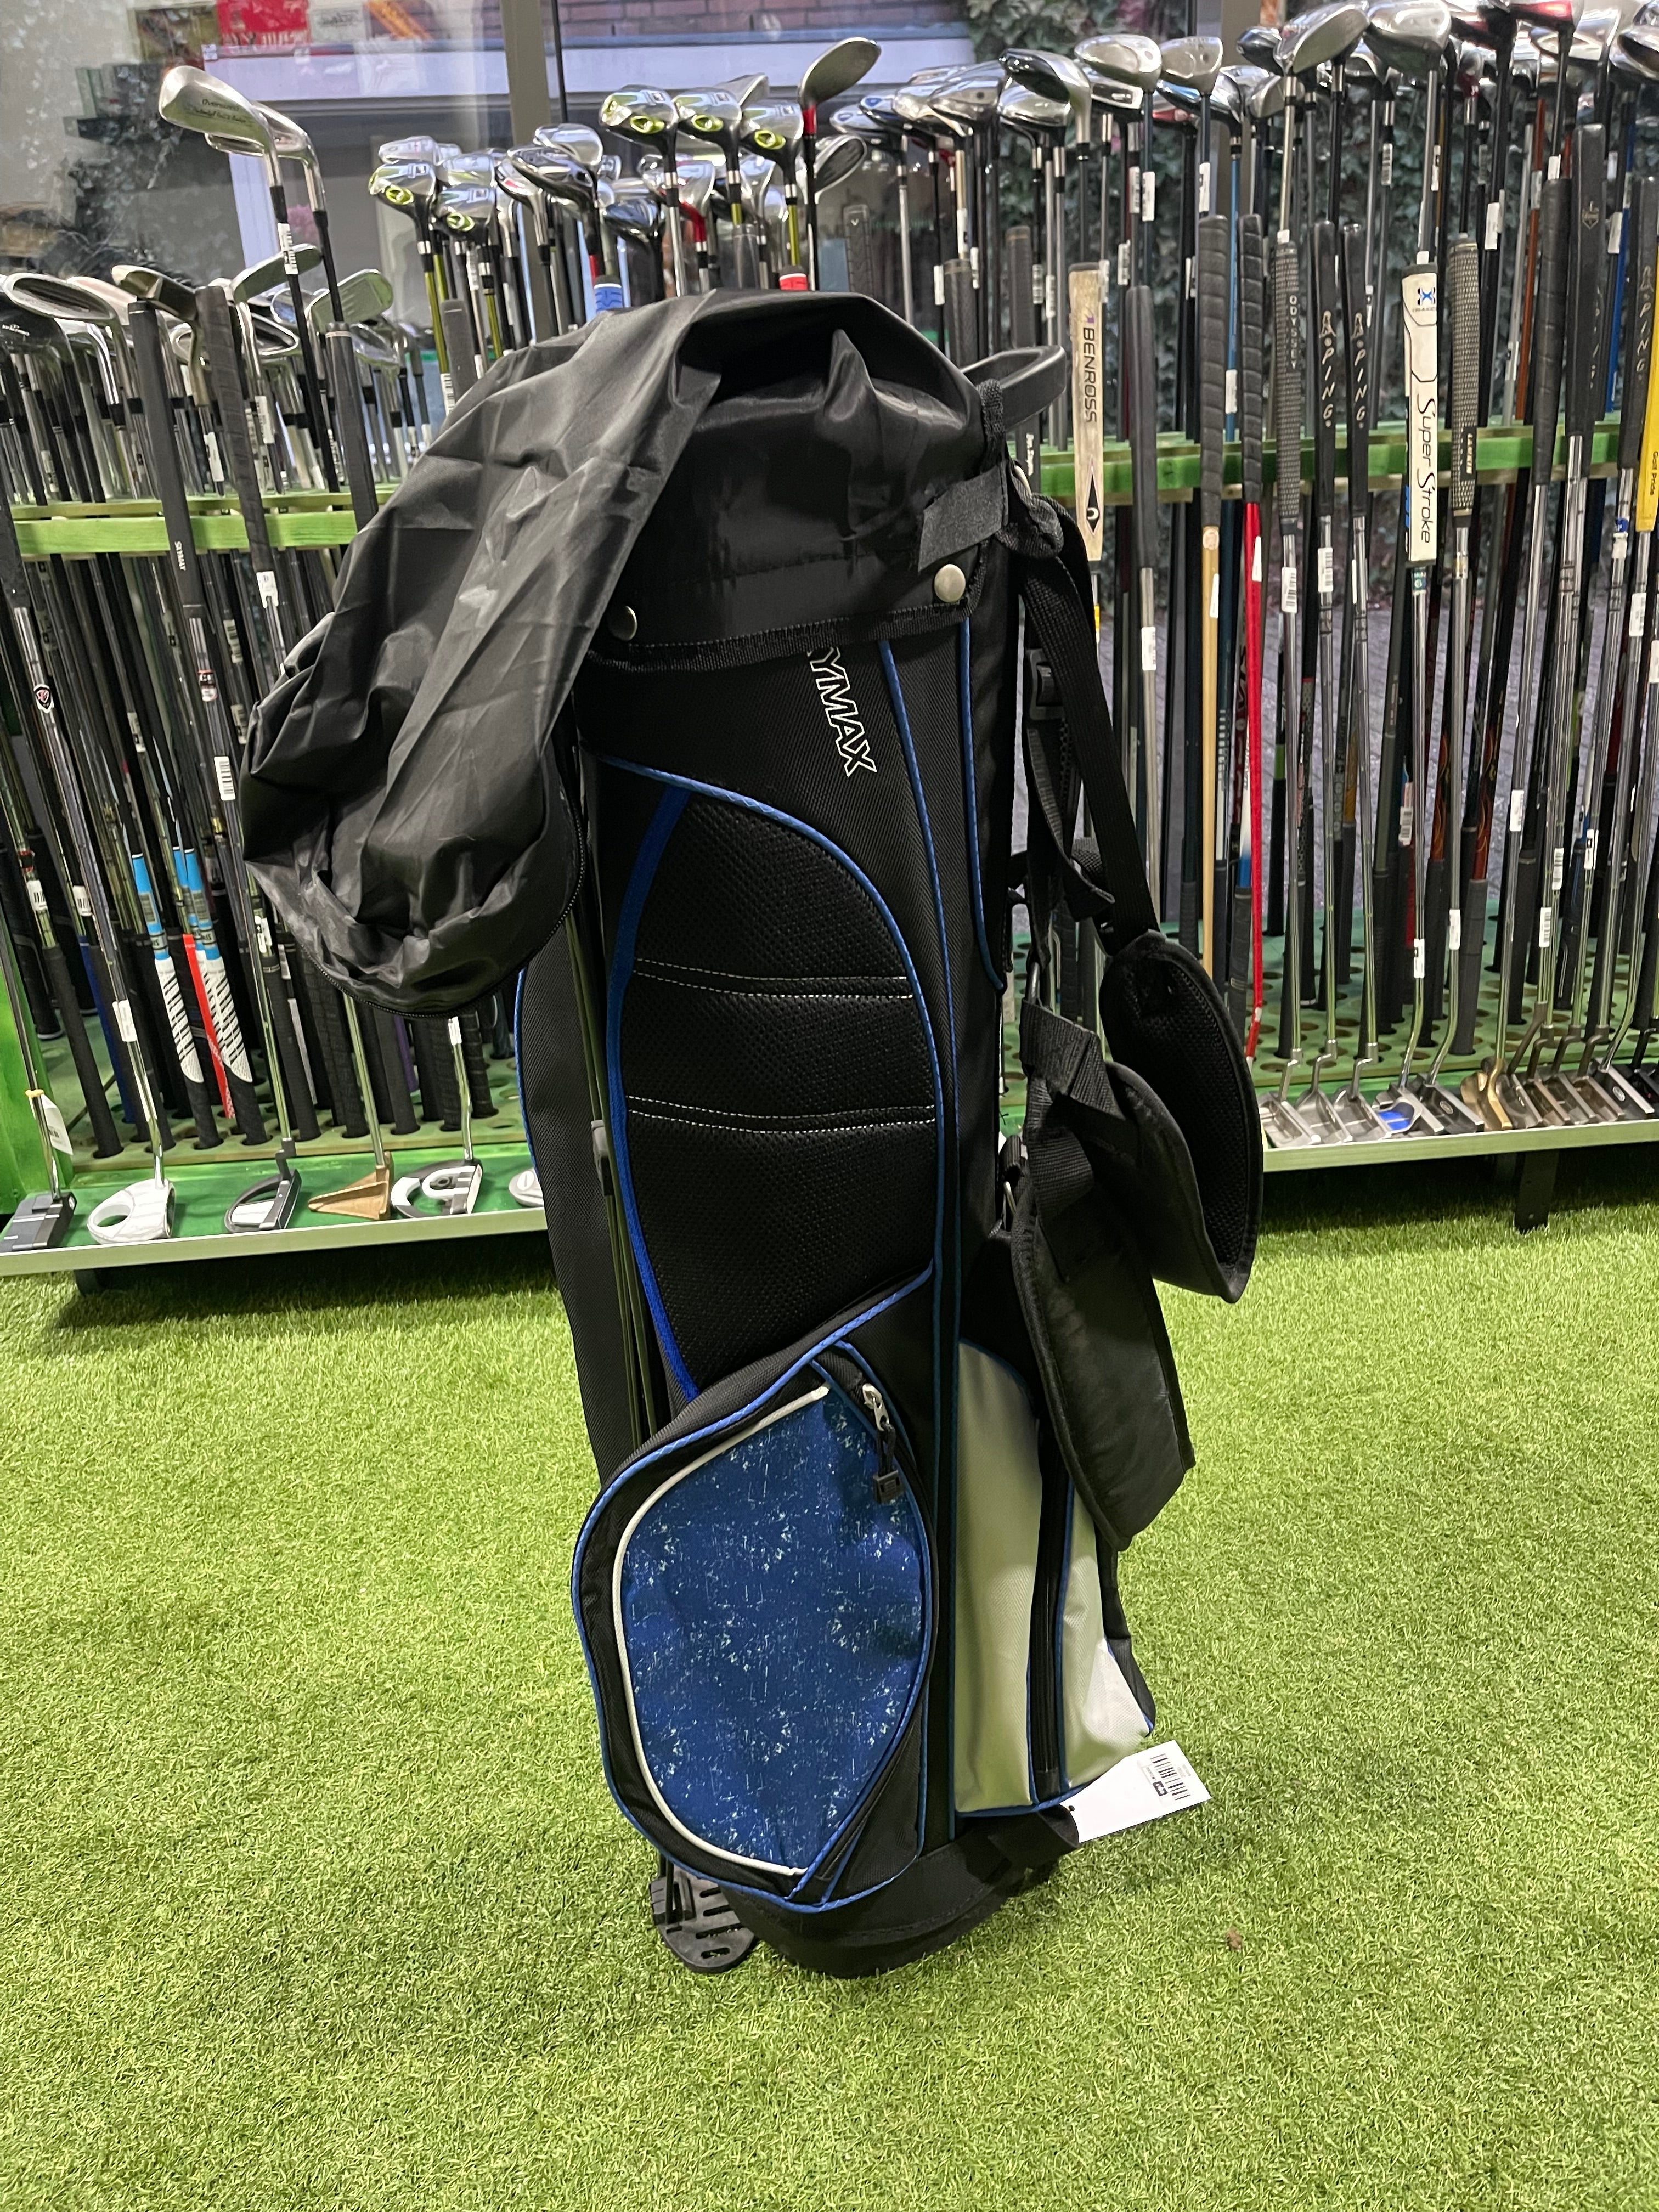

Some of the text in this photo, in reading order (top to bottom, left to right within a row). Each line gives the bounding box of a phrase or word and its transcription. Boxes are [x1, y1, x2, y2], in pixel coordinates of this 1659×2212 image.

[1289, 295, 1297, 369] ODYSSEY
[1083, 327, 1097, 422] BENROSS
[1322, 347, 1335, 419] PING
[1354, 348, 1367, 421] PING
[1417, 393, 1436, 543] Super Stroke
[807, 646, 877, 777] YMAX
